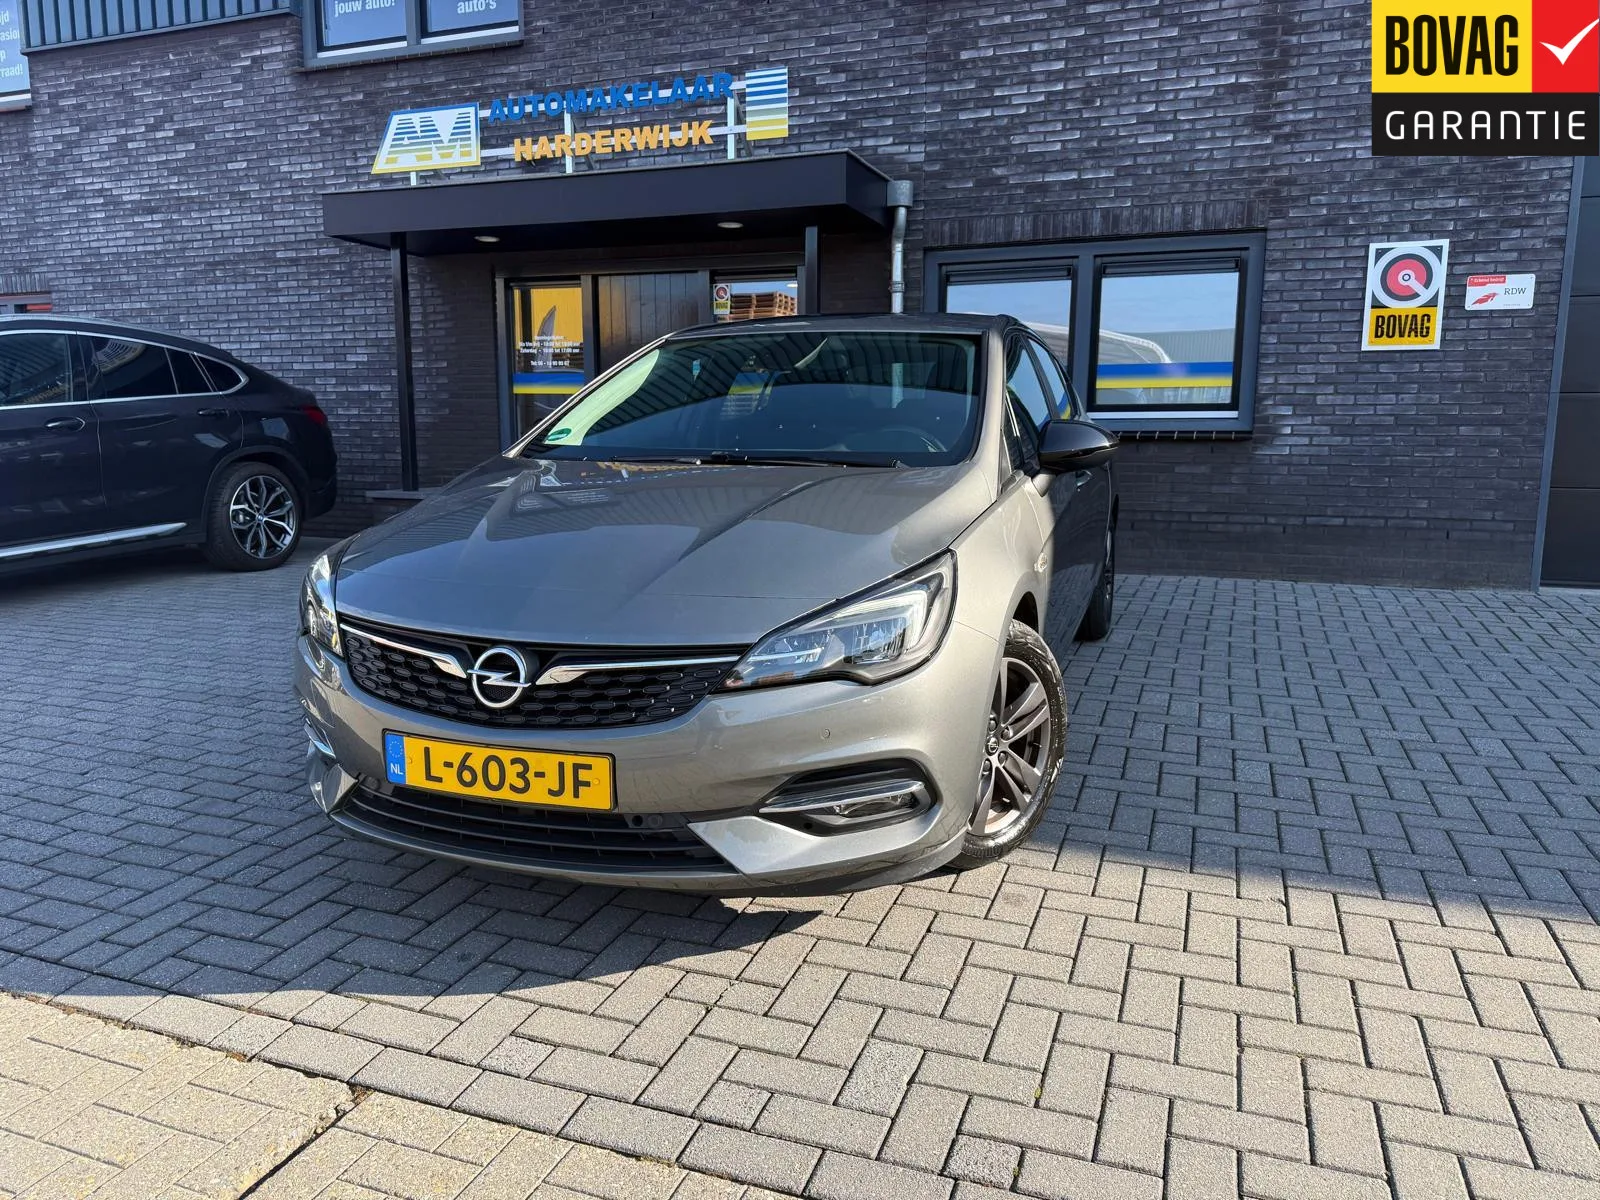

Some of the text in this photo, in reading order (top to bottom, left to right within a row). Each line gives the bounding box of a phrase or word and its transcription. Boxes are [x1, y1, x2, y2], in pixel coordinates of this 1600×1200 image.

[334, 1, 362, 18] jouw
[457, 0, 497, 14] auto's
[487, 72, 733, 123] AUTOMAKELAAR
[514, 119, 715, 162] HARDERWIJK
[1504, 287, 1527, 295] RDW
[1374, 313, 1431, 339] BOVAG
[390, 763, 404, 776] NL
[423, 746, 594, 800] L-603-JF
